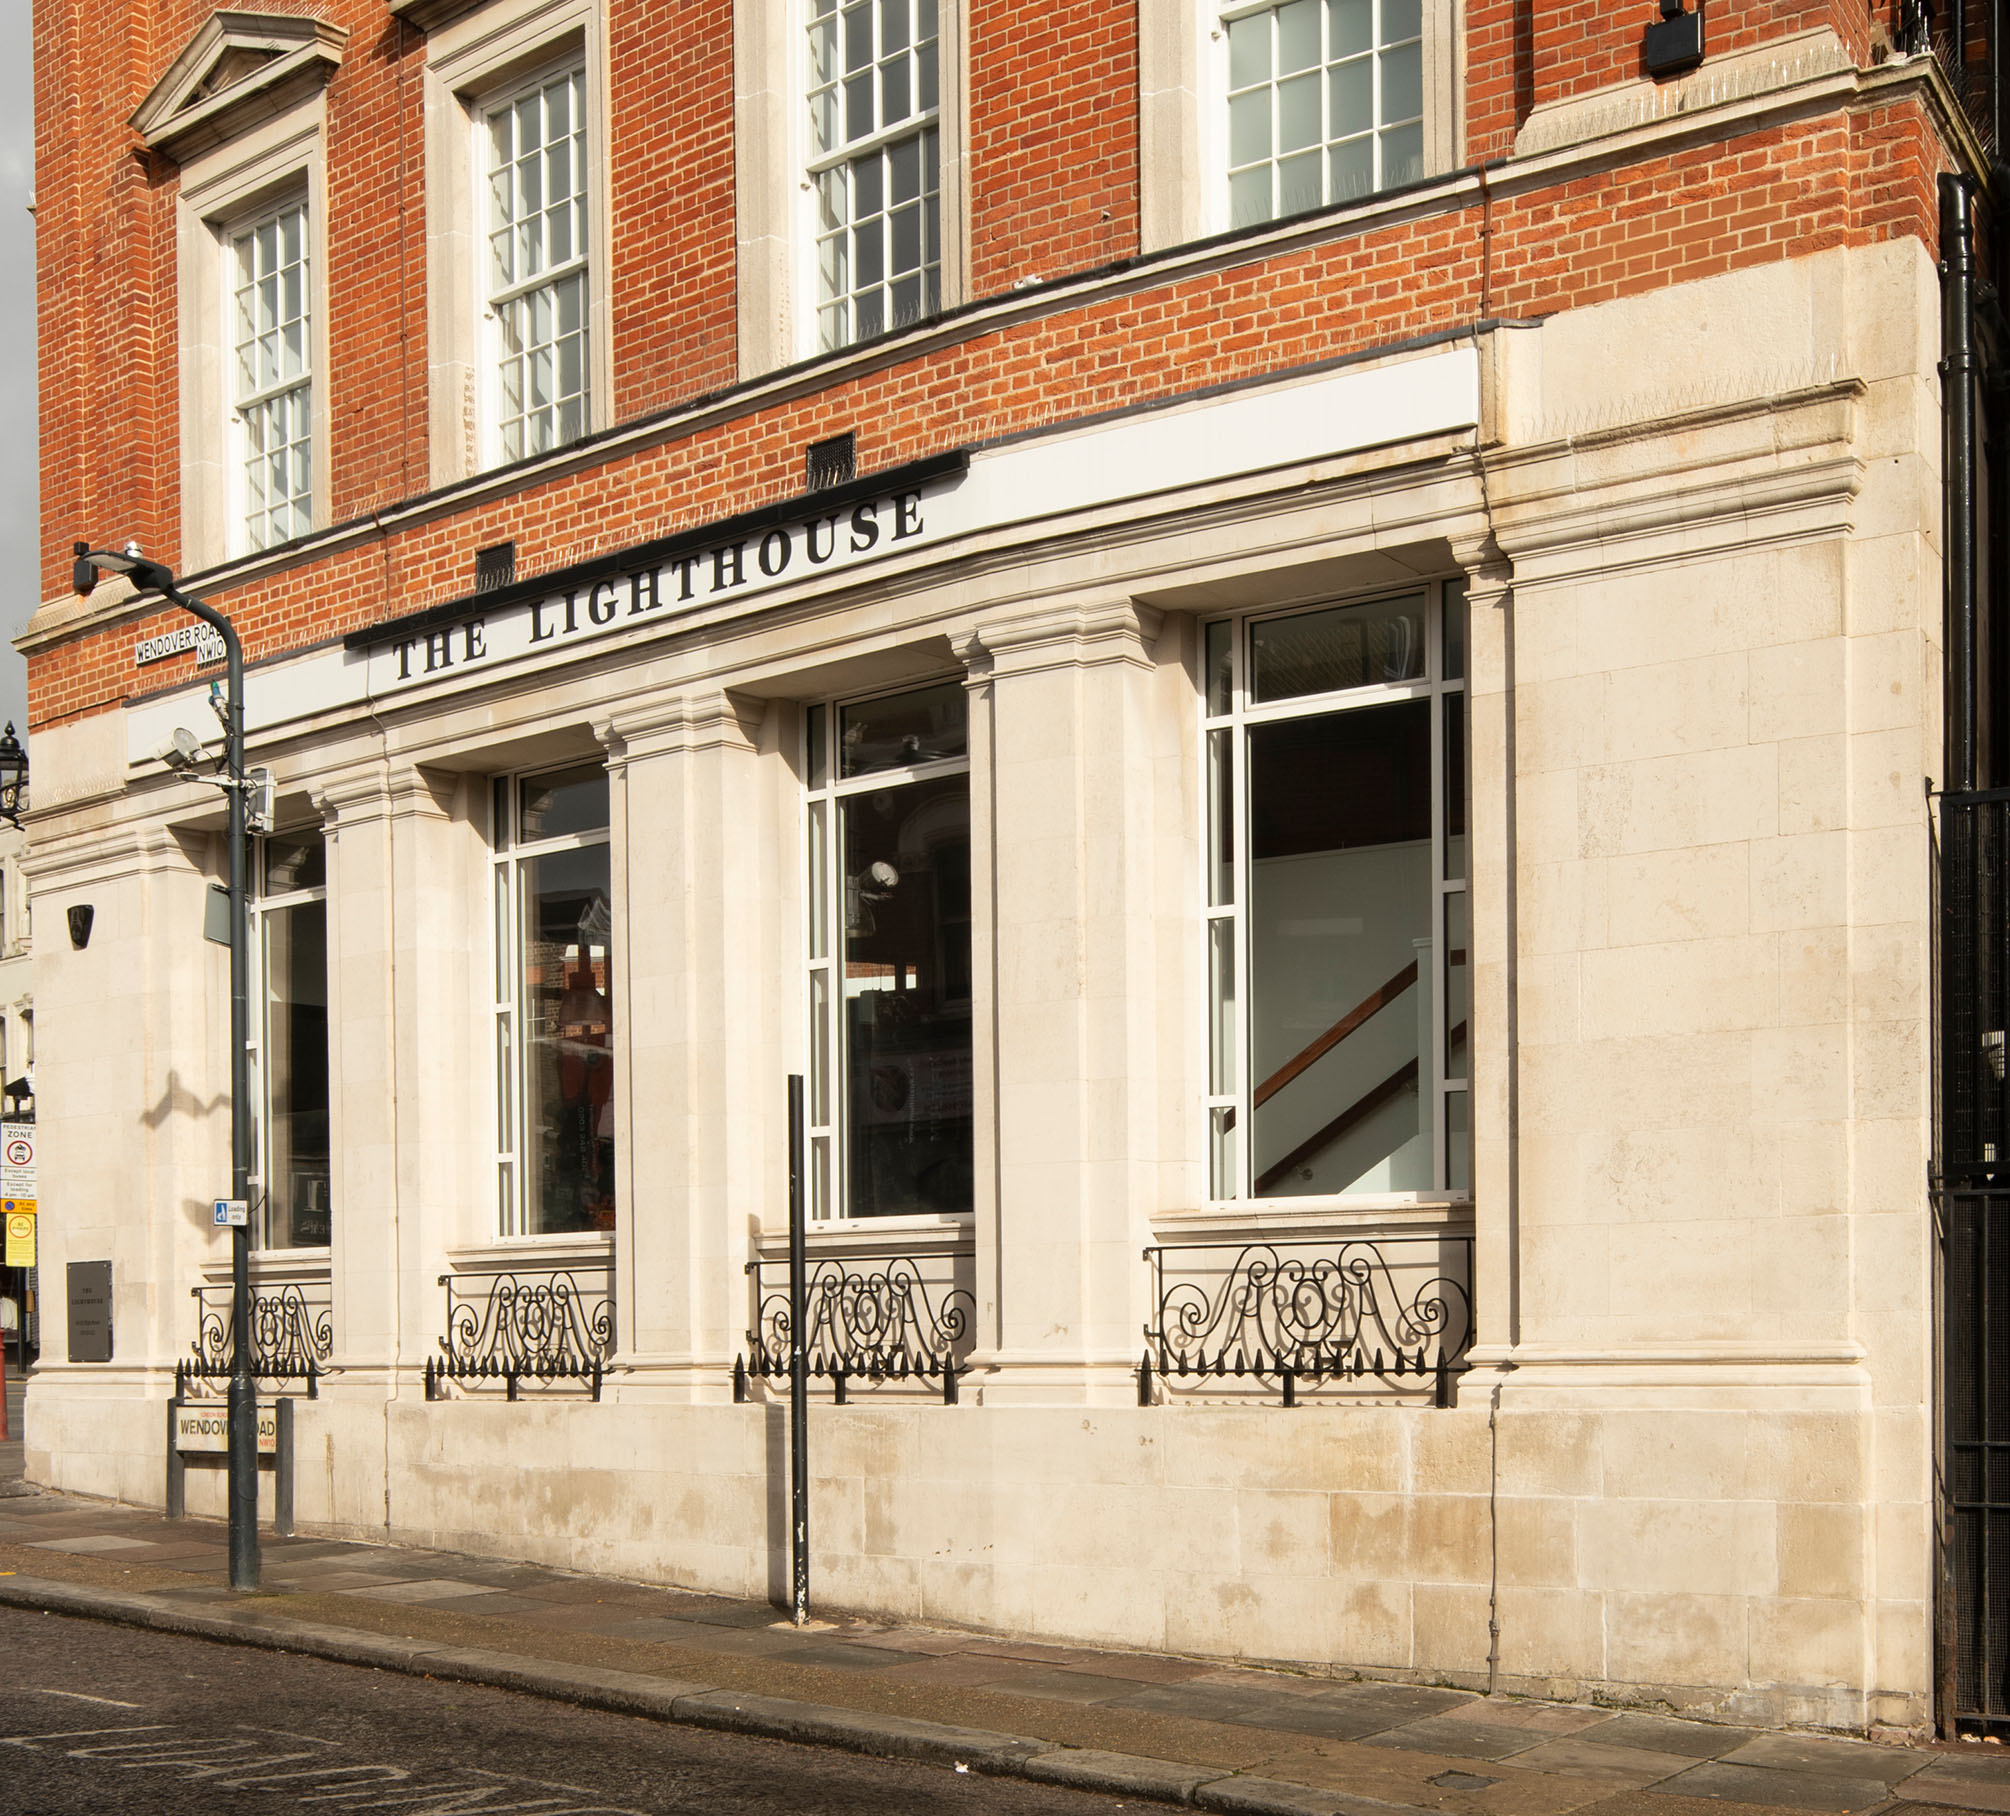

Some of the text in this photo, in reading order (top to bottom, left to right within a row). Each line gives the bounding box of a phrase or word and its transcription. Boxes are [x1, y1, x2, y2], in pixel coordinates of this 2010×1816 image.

[392, 489, 925, 680] THE LIGHTHOUSE
[136, 624, 221, 662] WENDOVER ROA
[180, 1420, 228, 1435] WENDOV
